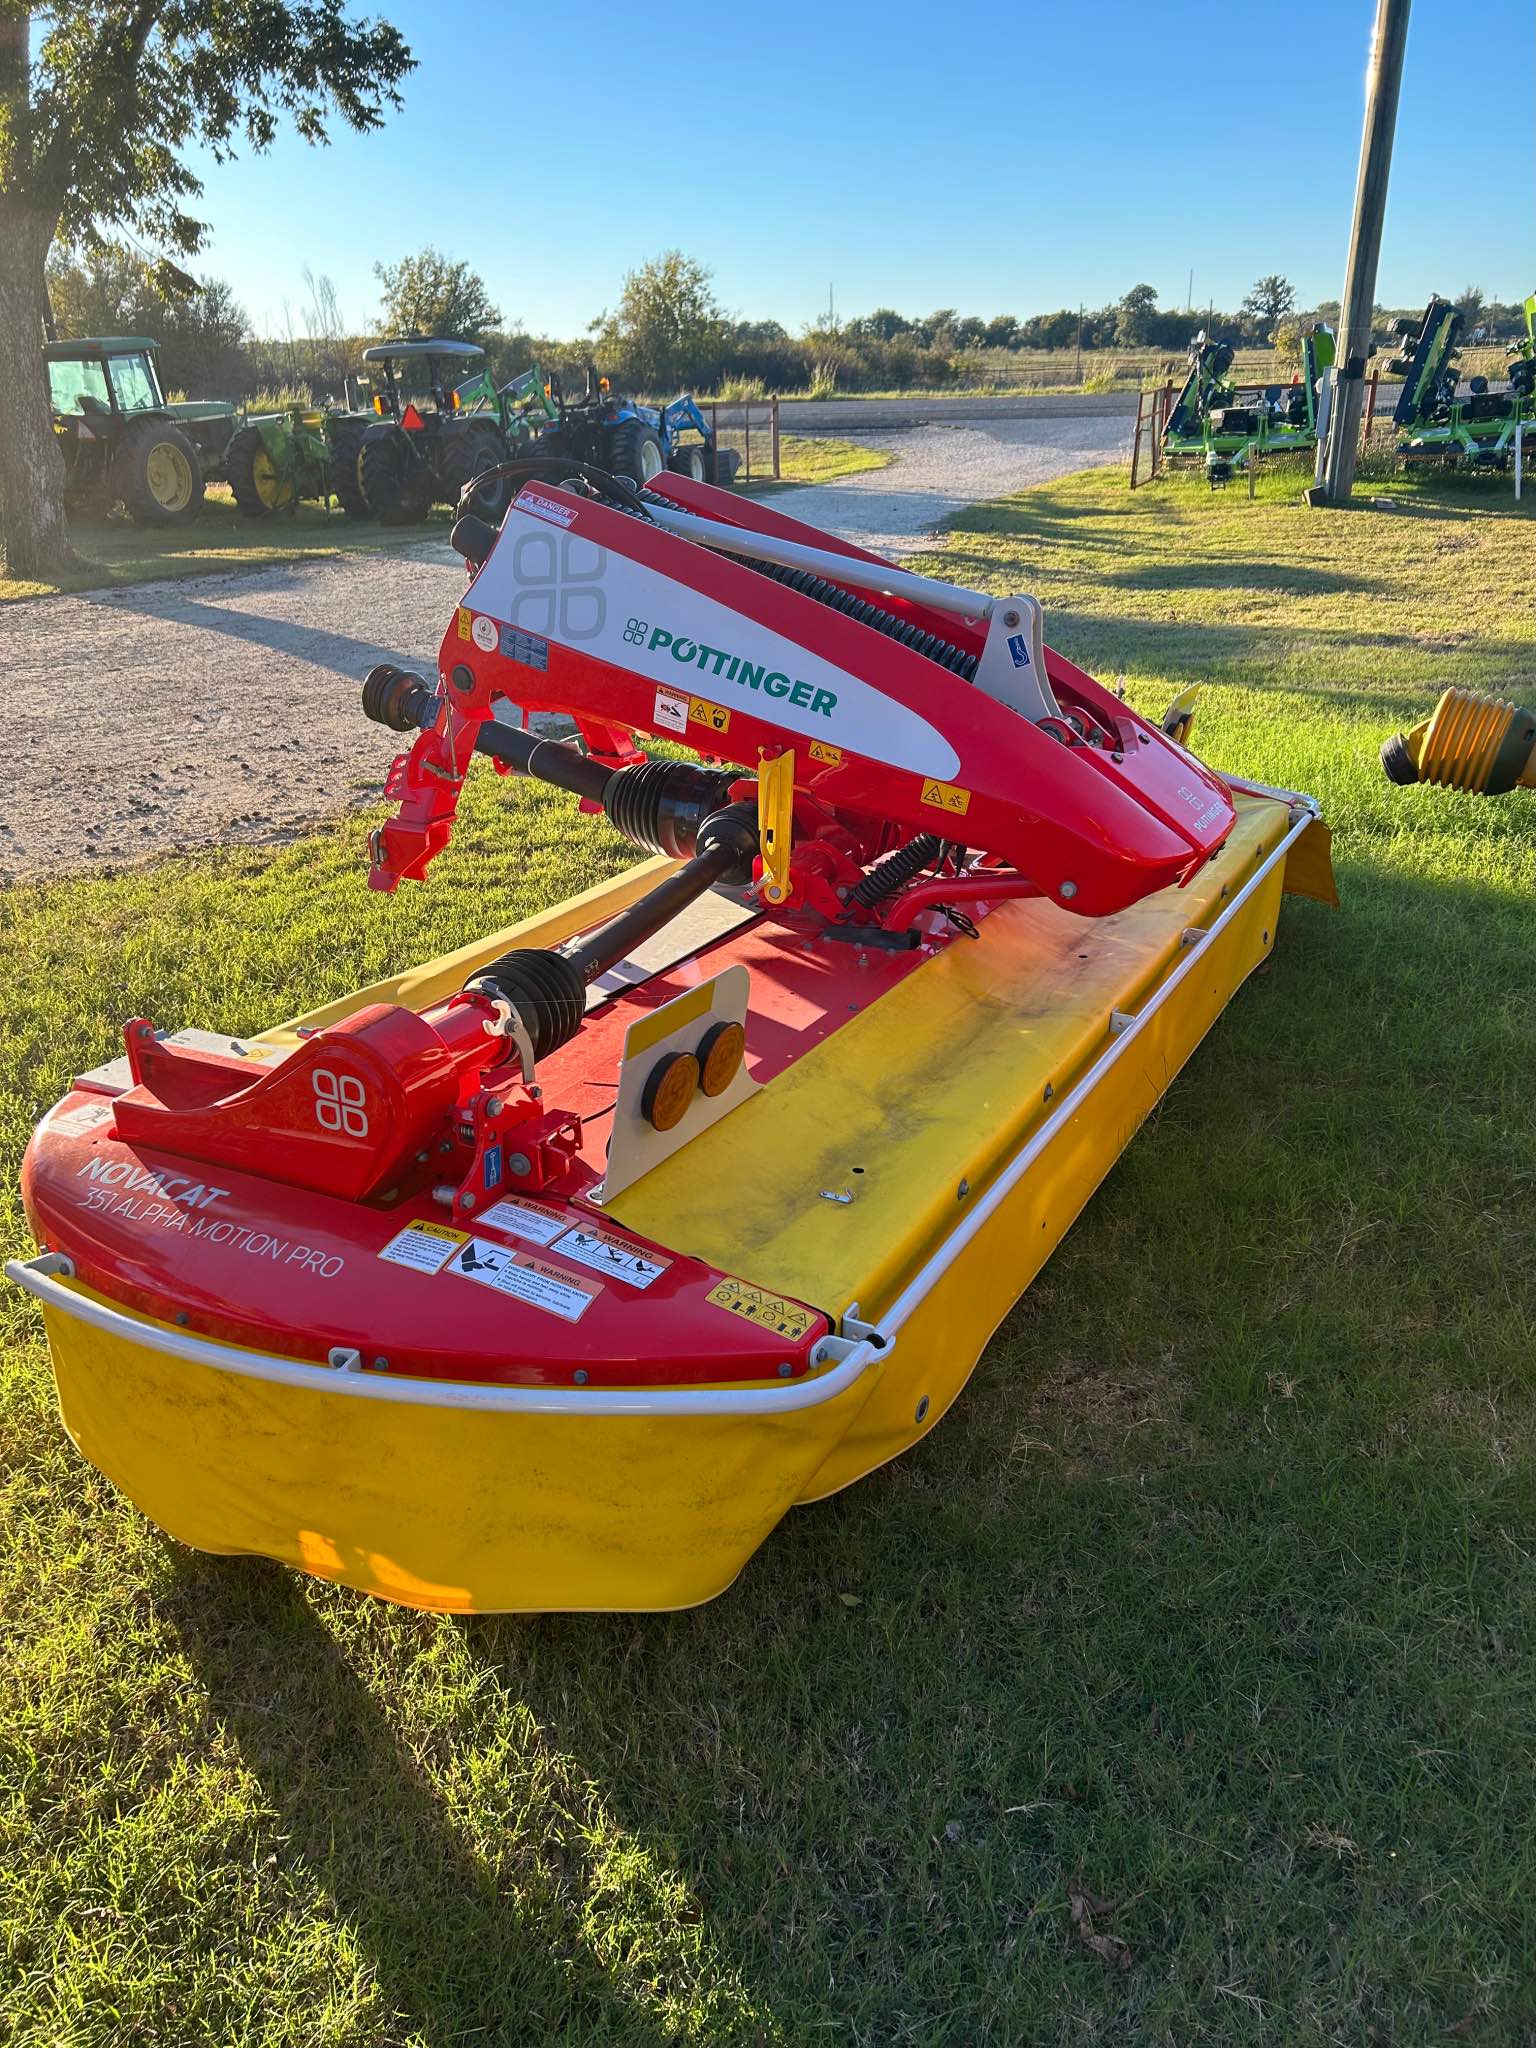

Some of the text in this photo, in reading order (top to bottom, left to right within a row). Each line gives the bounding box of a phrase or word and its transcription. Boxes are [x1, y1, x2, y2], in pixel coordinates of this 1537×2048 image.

[536, 499, 571, 517] DANGER
[76, 1157, 231, 1209] NOVACAT
[523, 1201, 568, 1222] WARNING
[77, 1187, 113, 1212] 351
[111, 1197, 190, 1231] ALPHA
[188, 1217, 290, 1260] MOTION
[285, 1245, 345, 1278] PRO
[426, 1226, 459, 1239] CAUTION
[602, 1233, 655, 1259] WARNING
[539, 1265, 582, 1287] WARNING
